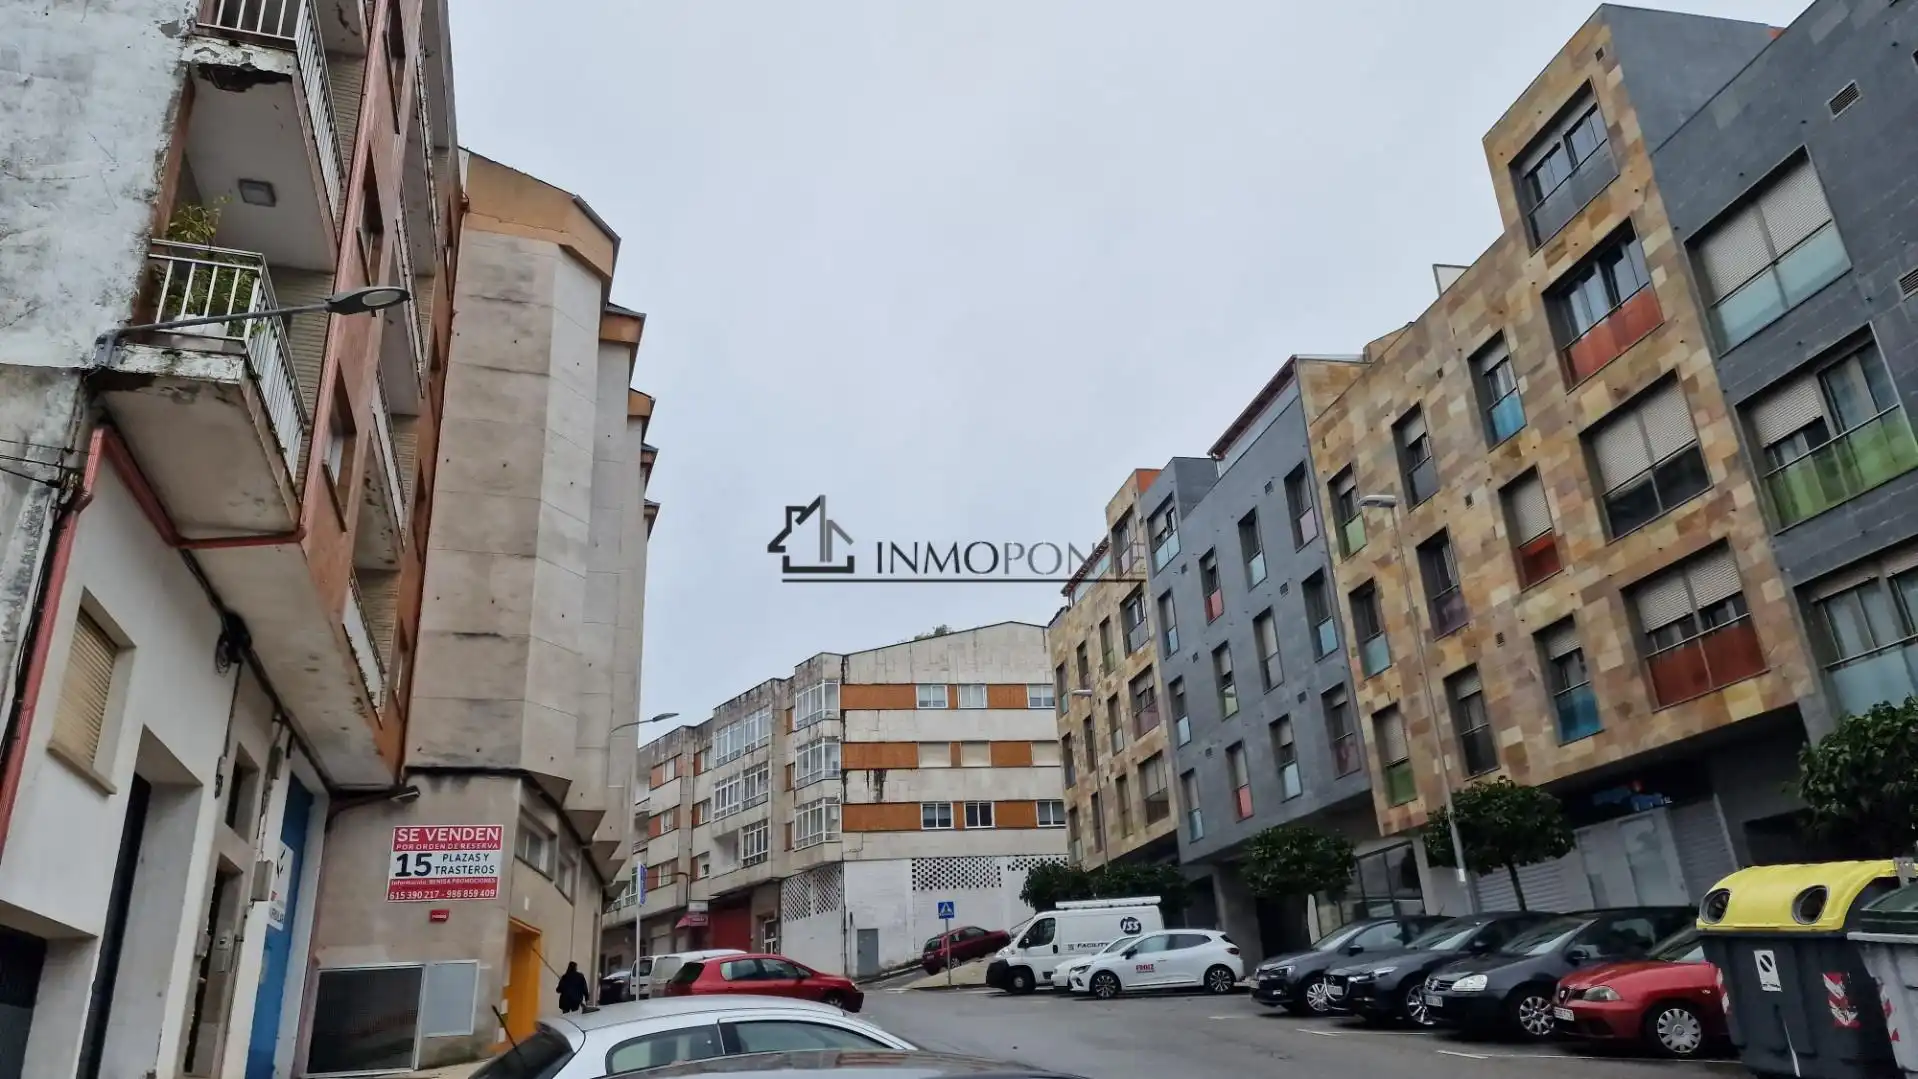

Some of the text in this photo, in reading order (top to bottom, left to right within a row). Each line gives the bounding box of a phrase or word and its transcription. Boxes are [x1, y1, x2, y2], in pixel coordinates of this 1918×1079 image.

[397, 827, 500, 842] SE VENDEN
[447, 842, 459, 850] DE
[442, 853, 490, 862] PLAZAS Y
[395, 853, 432, 877] 15
[435, 865, 495, 875] TRASTEROS
[407, 891, 423, 899] 390
[424, 890, 440, 899] 217
[480, 889, 495, 897] 409
